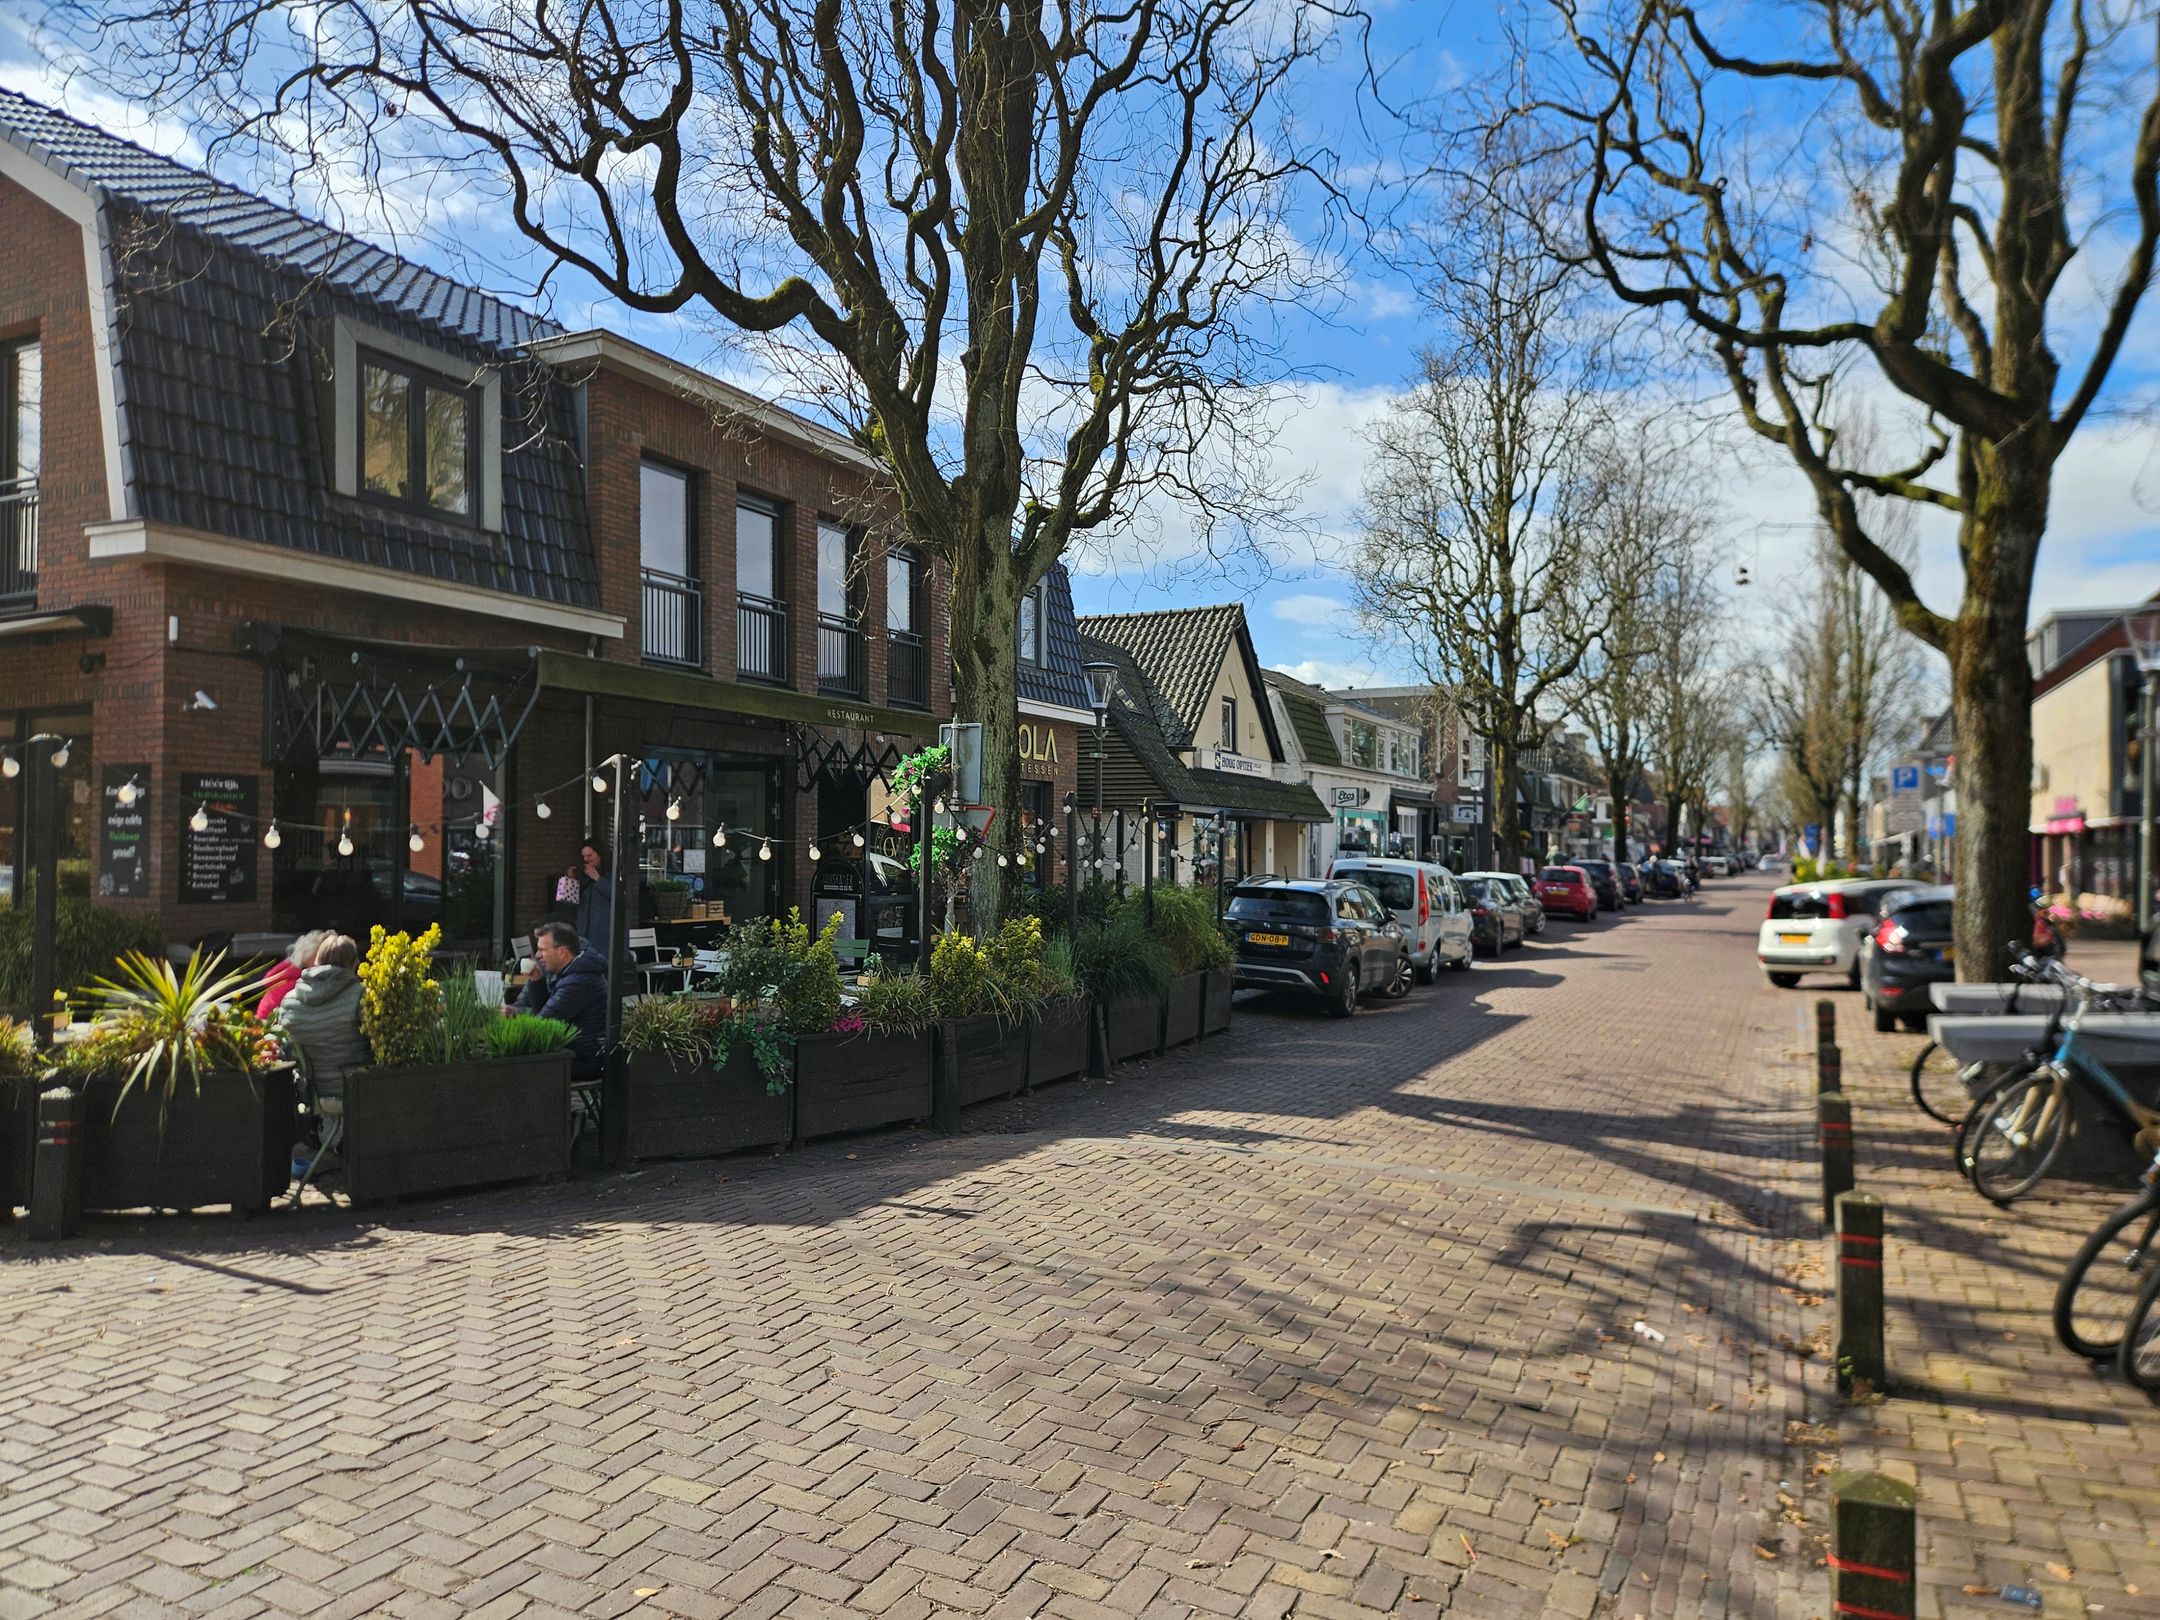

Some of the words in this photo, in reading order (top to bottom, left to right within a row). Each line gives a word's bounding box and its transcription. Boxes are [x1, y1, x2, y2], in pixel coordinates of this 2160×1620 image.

[826, 708, 875, 723] RESTAURANT
[1899, 767, 1912, 786] P
[1337, 790, 1355, 801] Etos
[1345, 851, 1359, 859] Etos
